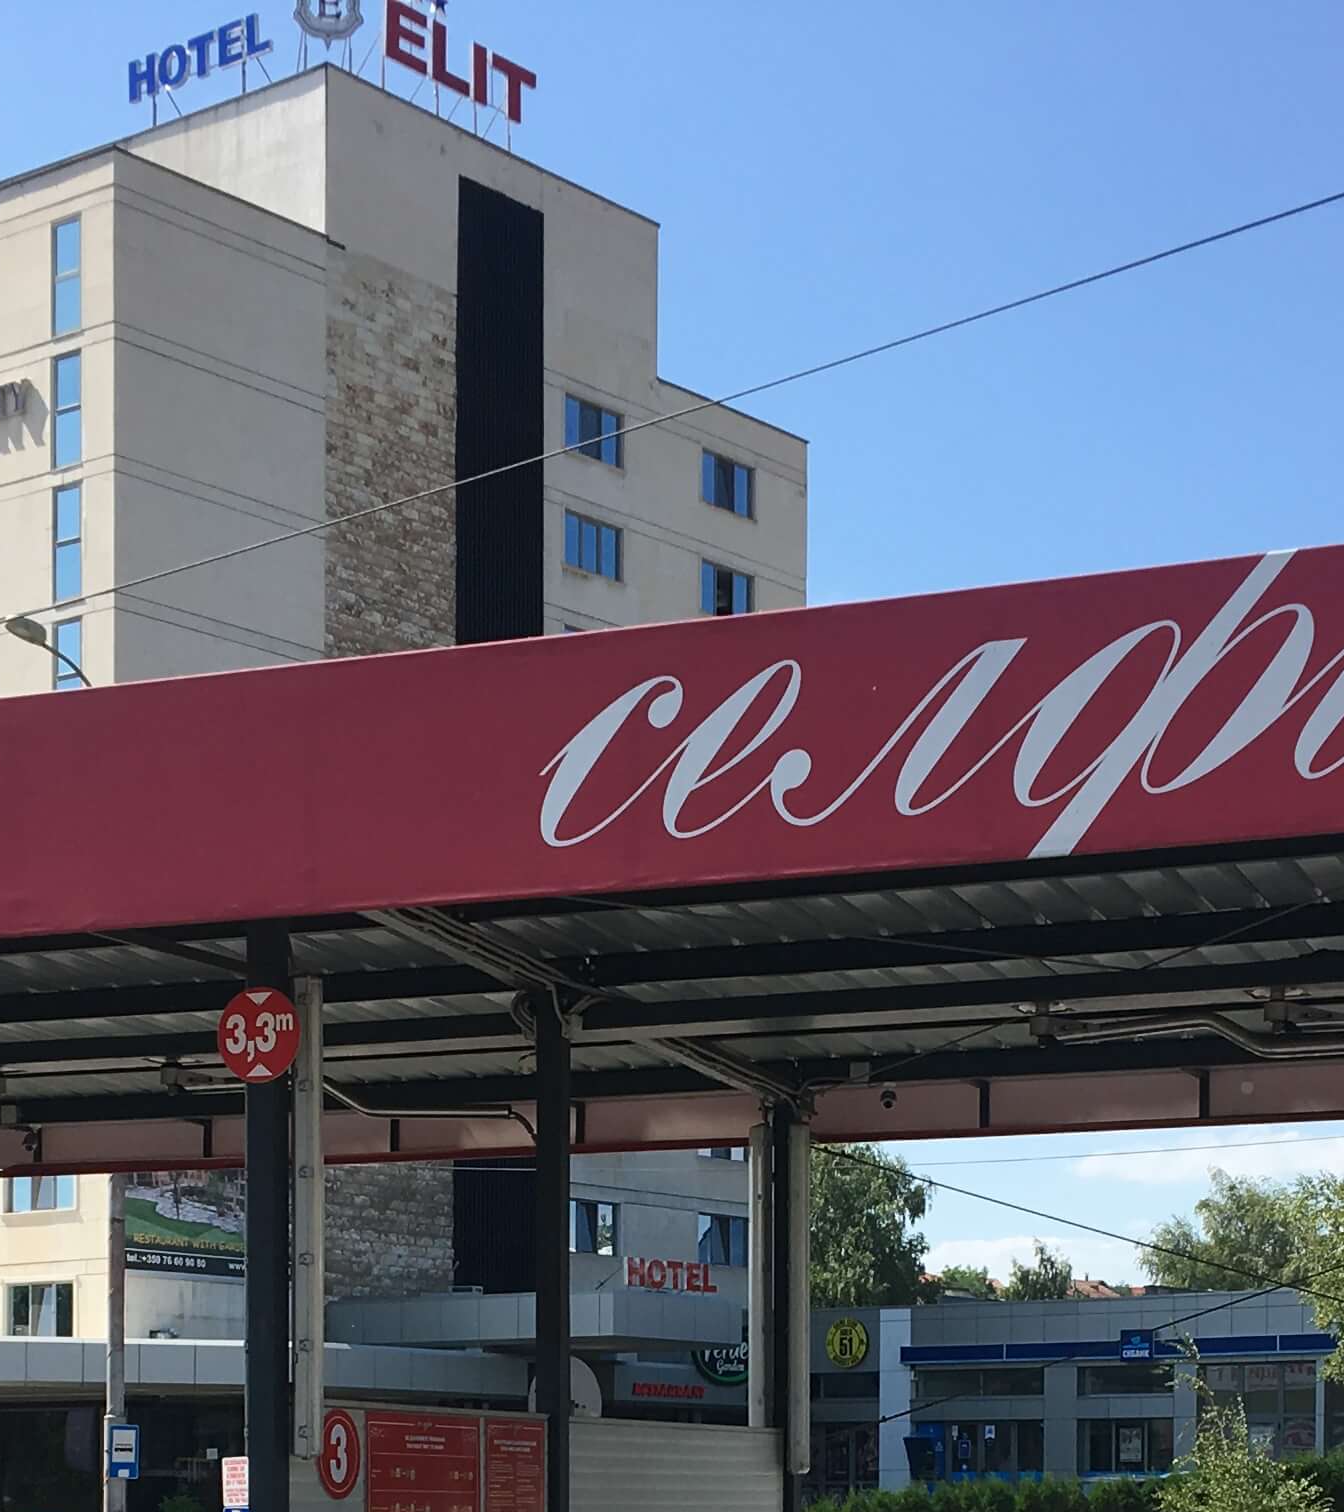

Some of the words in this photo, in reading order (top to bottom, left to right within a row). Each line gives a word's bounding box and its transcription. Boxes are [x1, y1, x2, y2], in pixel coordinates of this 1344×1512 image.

[128, 13, 273, 104] HOTEL
[385, 0, 537, 124] ELIT
[625, 1256, 718, 1293] HOTEL
[329, 1423, 348, 1484] 3
